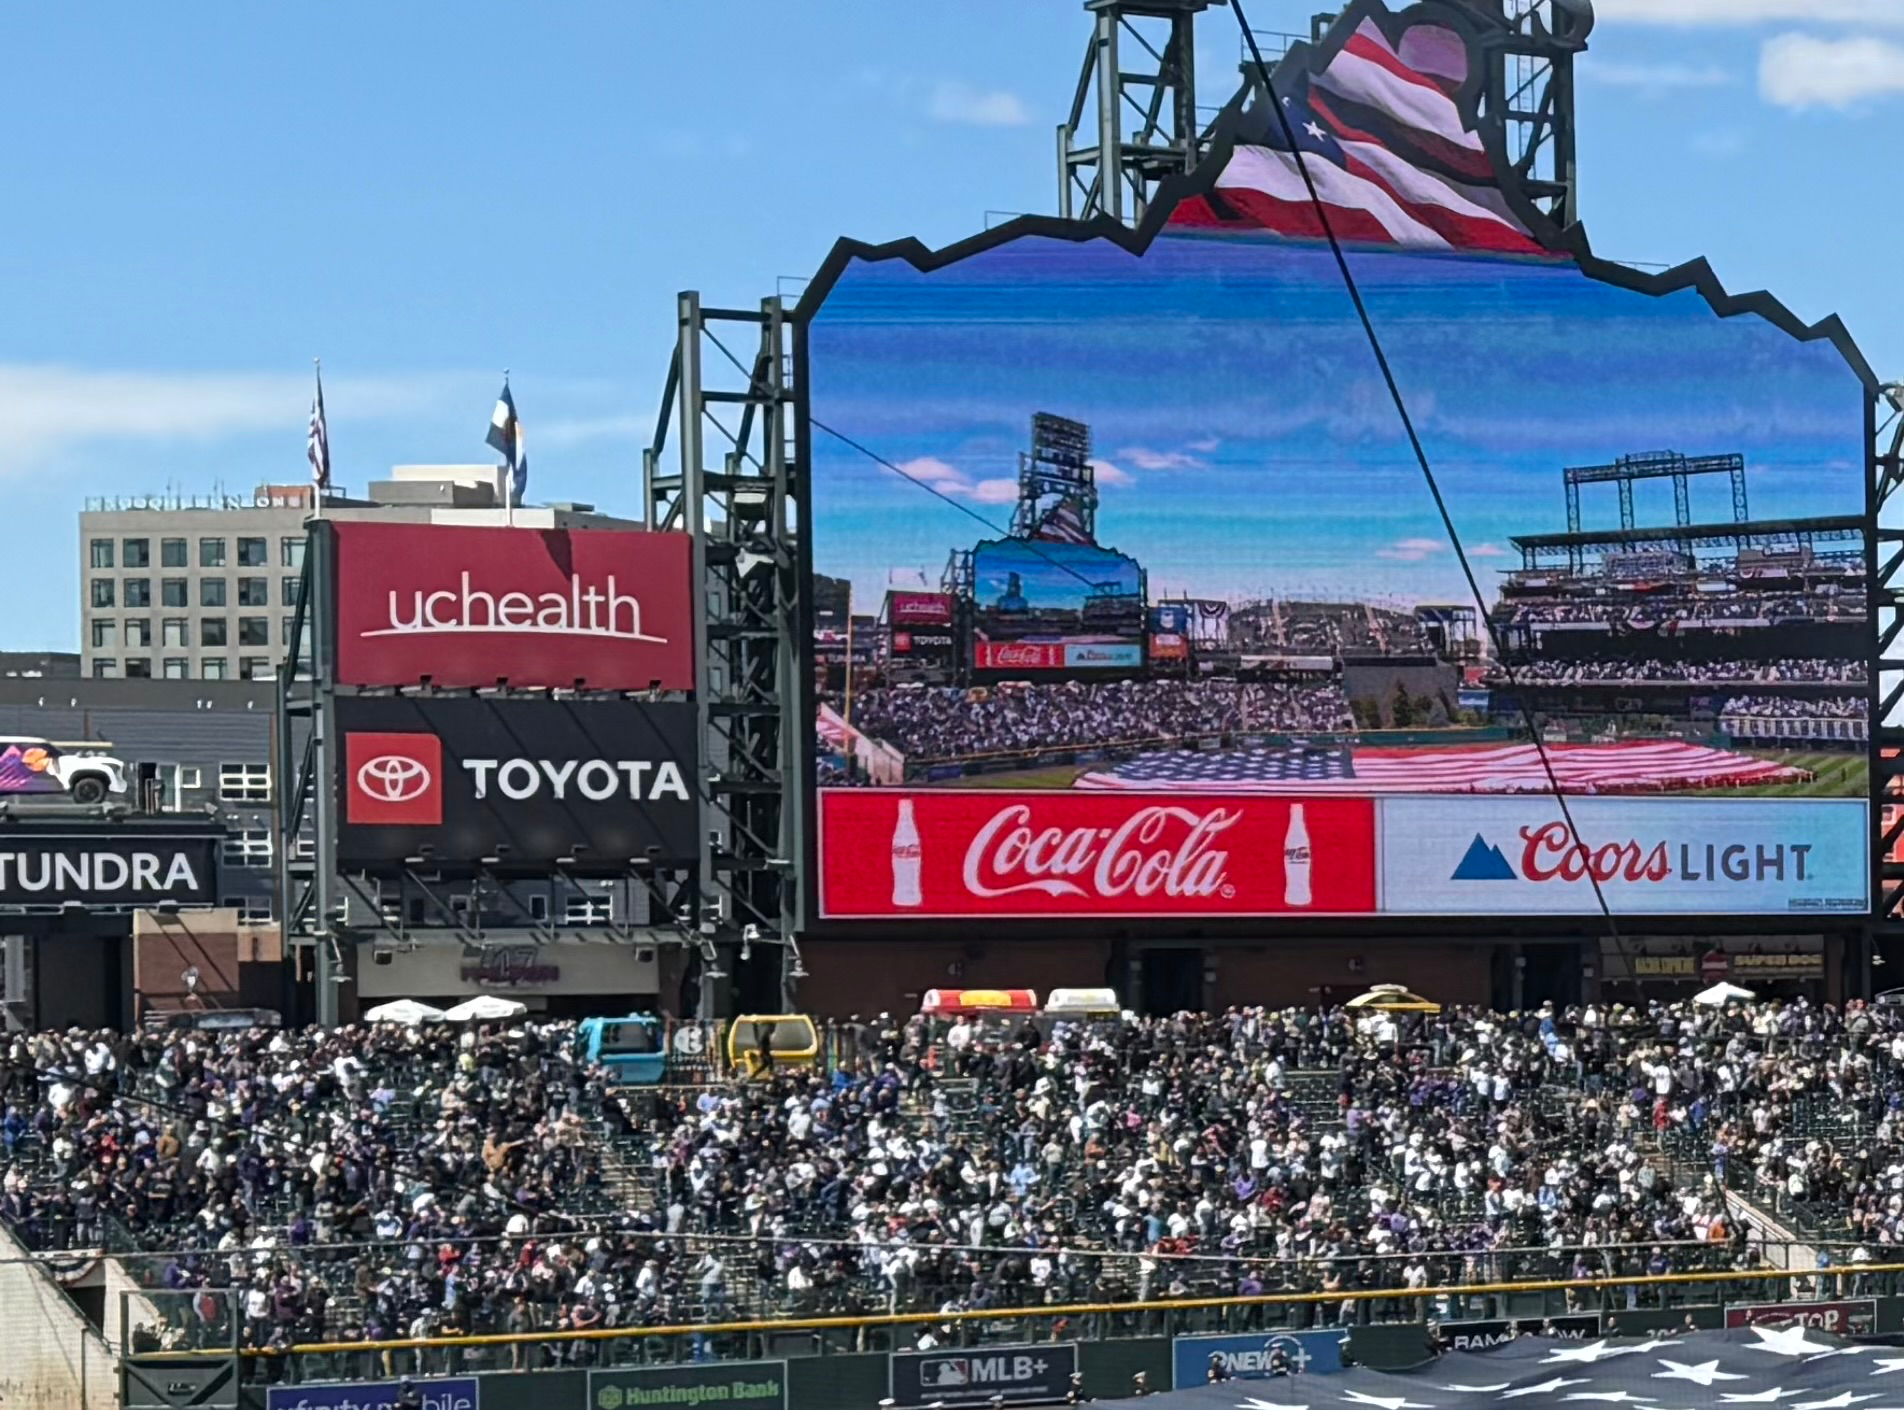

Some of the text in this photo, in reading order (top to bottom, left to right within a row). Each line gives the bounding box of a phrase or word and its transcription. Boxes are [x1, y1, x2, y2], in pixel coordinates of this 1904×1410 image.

[389, 571, 642, 635] uchealth
[463, 759, 690, 801] TOYOTA
[0, 851, 198, 892] TUNDRA
[963, 804, 1245, 898] Coca-Cola
[1519, 820, 1813, 882] Coors LIGHT
[971, 1357, 1049, 1384] MLB+
[625, 1379, 779, 1408] Huntington Bank
